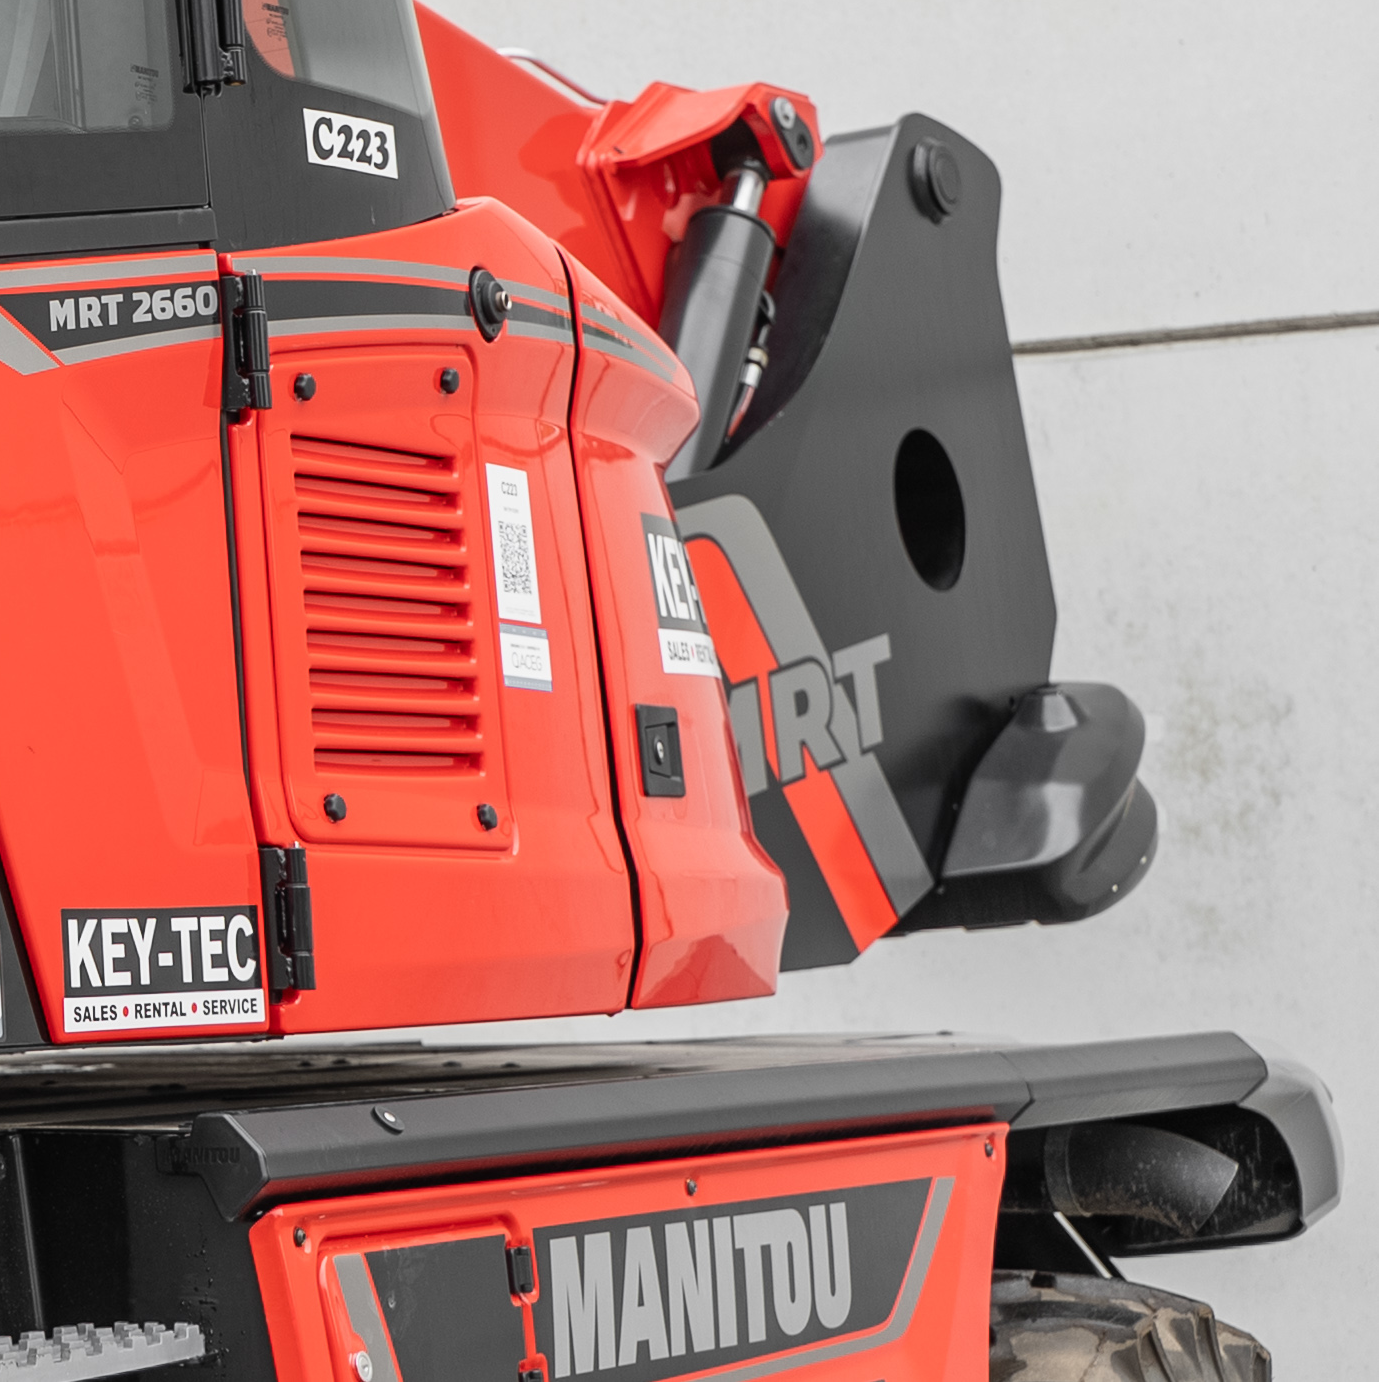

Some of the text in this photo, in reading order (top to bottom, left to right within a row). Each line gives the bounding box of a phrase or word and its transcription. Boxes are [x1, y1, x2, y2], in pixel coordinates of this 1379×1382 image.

[312, 116, 390, 170] C223
[49, 285, 218, 332] MRT 2660
[501, 481, 518, 496] C223
[667, 640, 690, 661] SALES
[67, 914, 257, 988] KEY-TEC
[73, 998, 258, 1023] SALES RENTAL SERVICE
[549, 1201, 852, 1379] MANITOU
